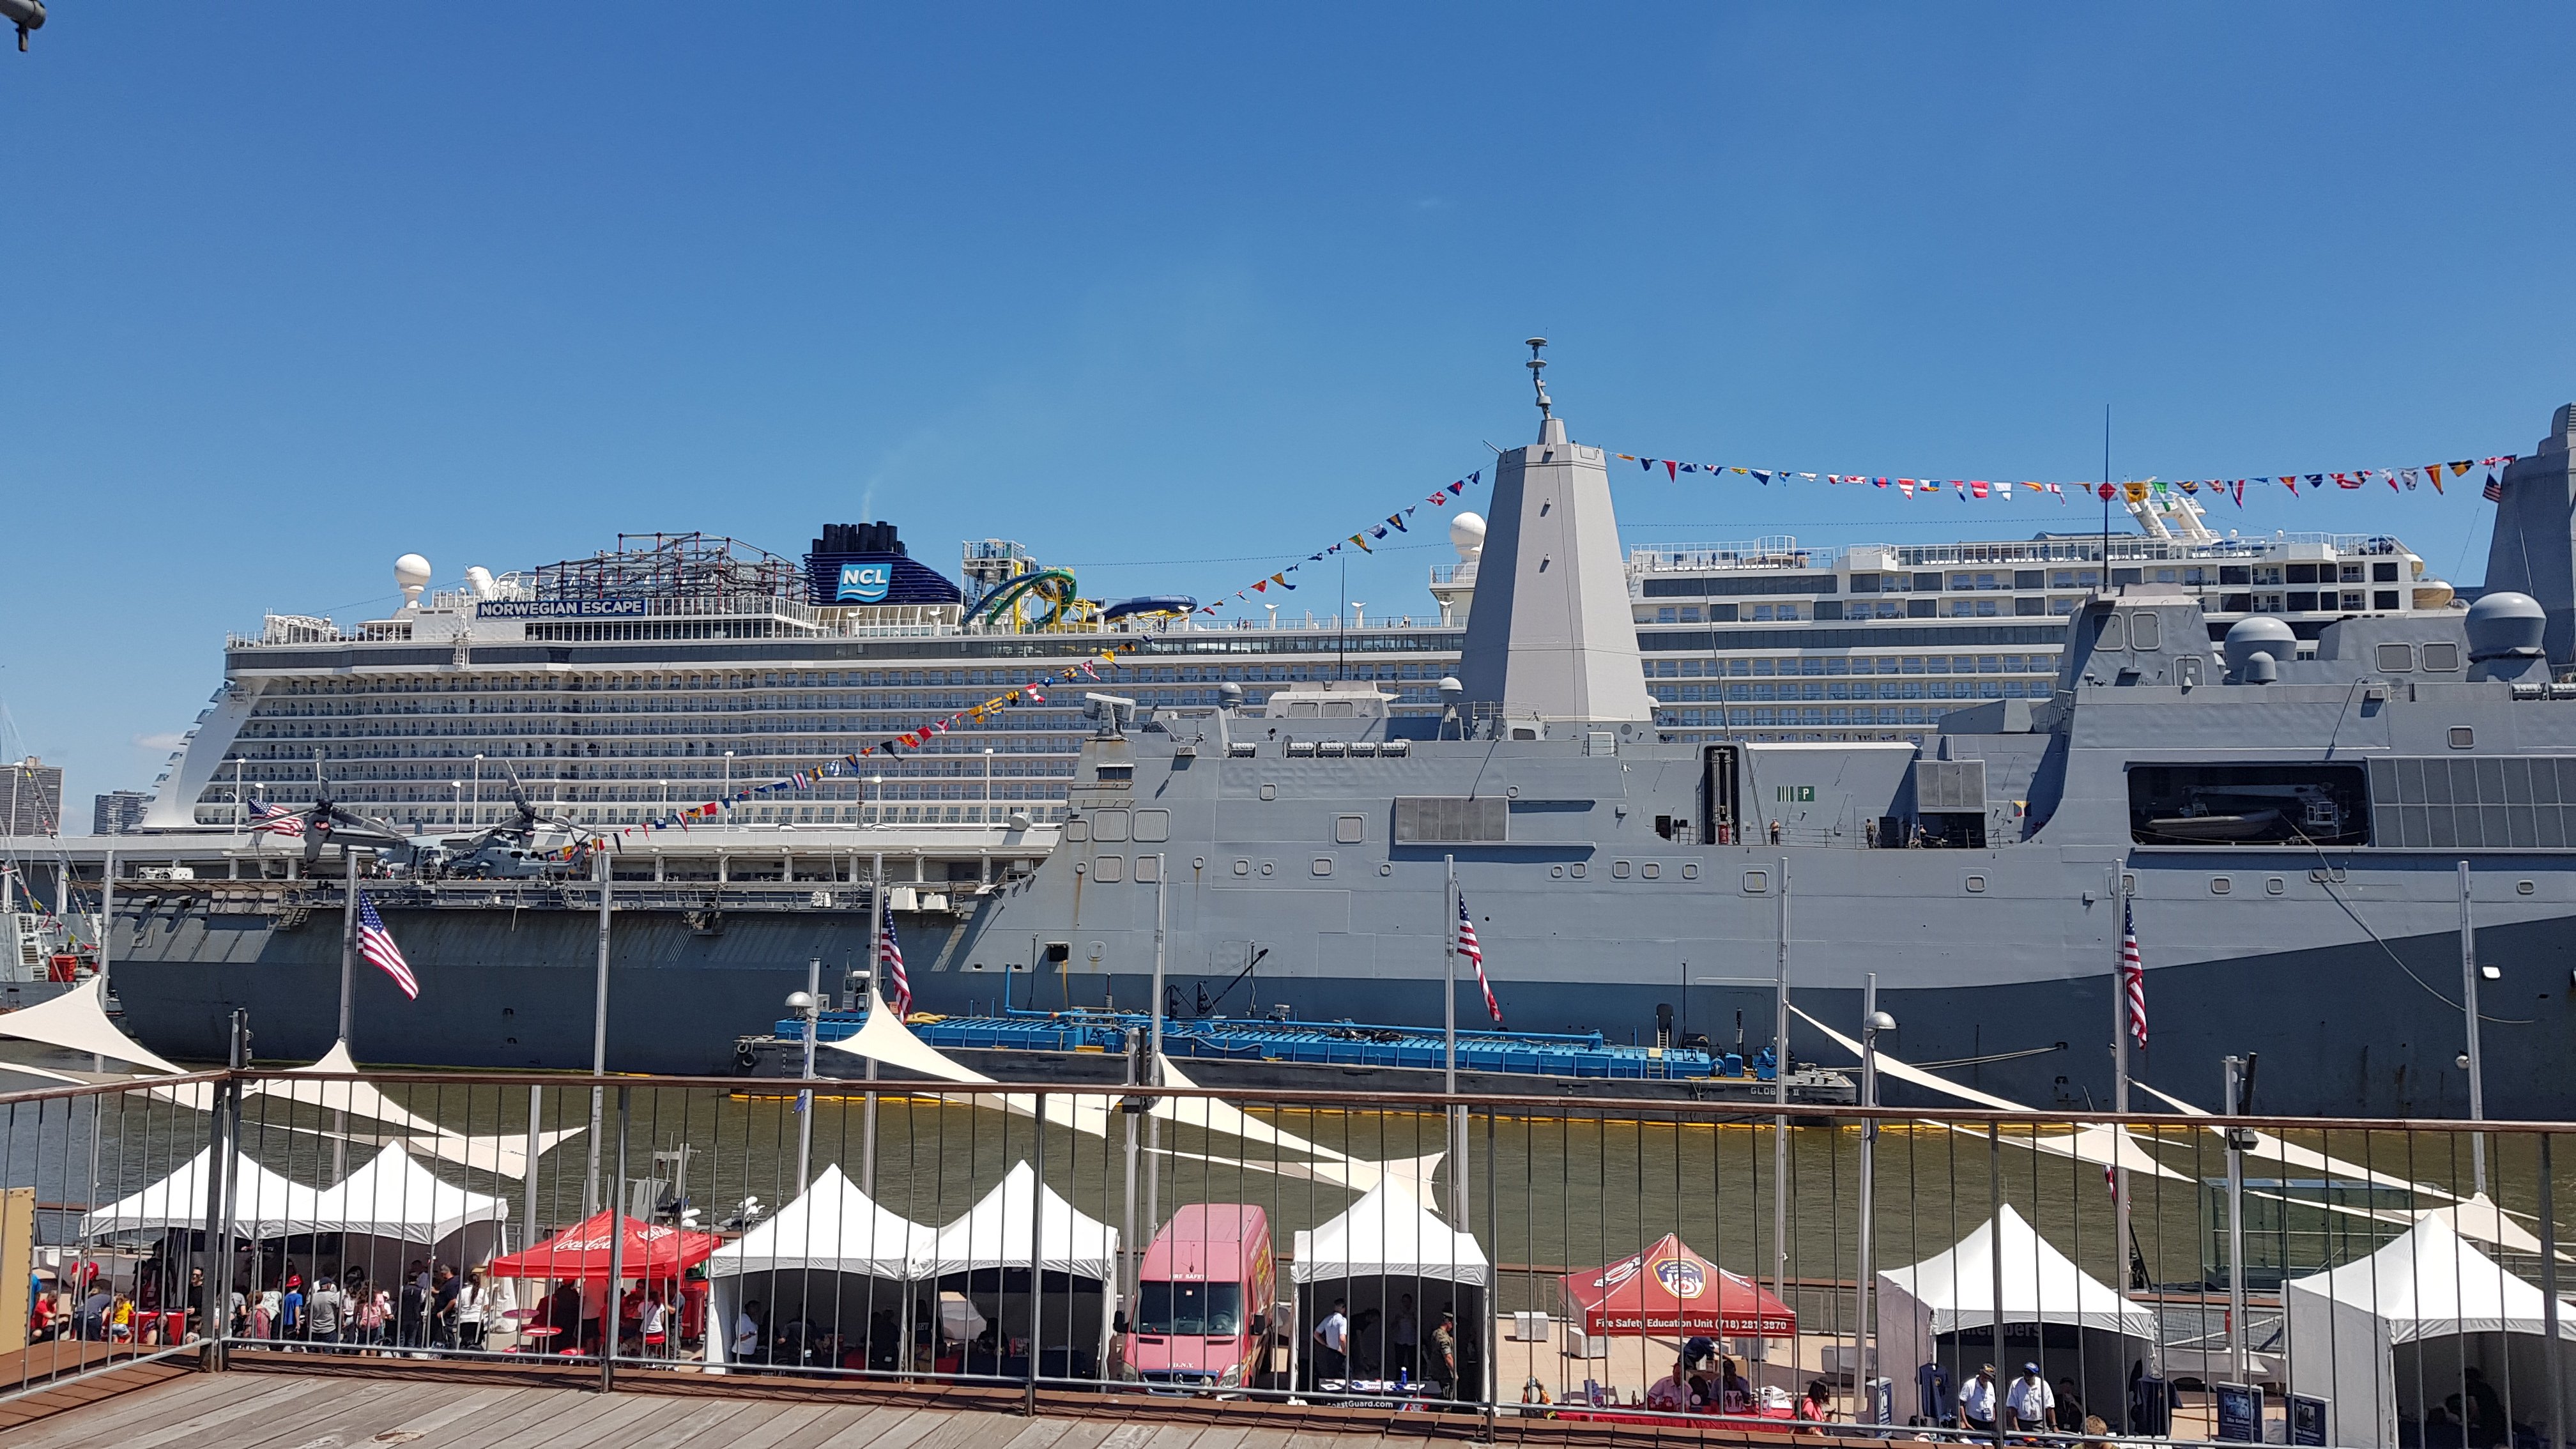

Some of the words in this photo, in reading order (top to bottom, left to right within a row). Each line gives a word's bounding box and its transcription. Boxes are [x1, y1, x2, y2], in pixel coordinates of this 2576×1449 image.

[843, 569, 887, 585] NCL
[480, 602, 578, 616] NORWEGIAN
[581, 601, 642, 614] ESCAPE
[1803, 788, 1809, 800] P
[1751, 1087, 1789, 1096] GLOB
[1616, 1319, 1644, 1330] Safety
[1647, 1319, 1692, 1328] Education
[1694, 1319, 1713, 1328] Unit
[1715, 1319, 1740, 1330] (718)
